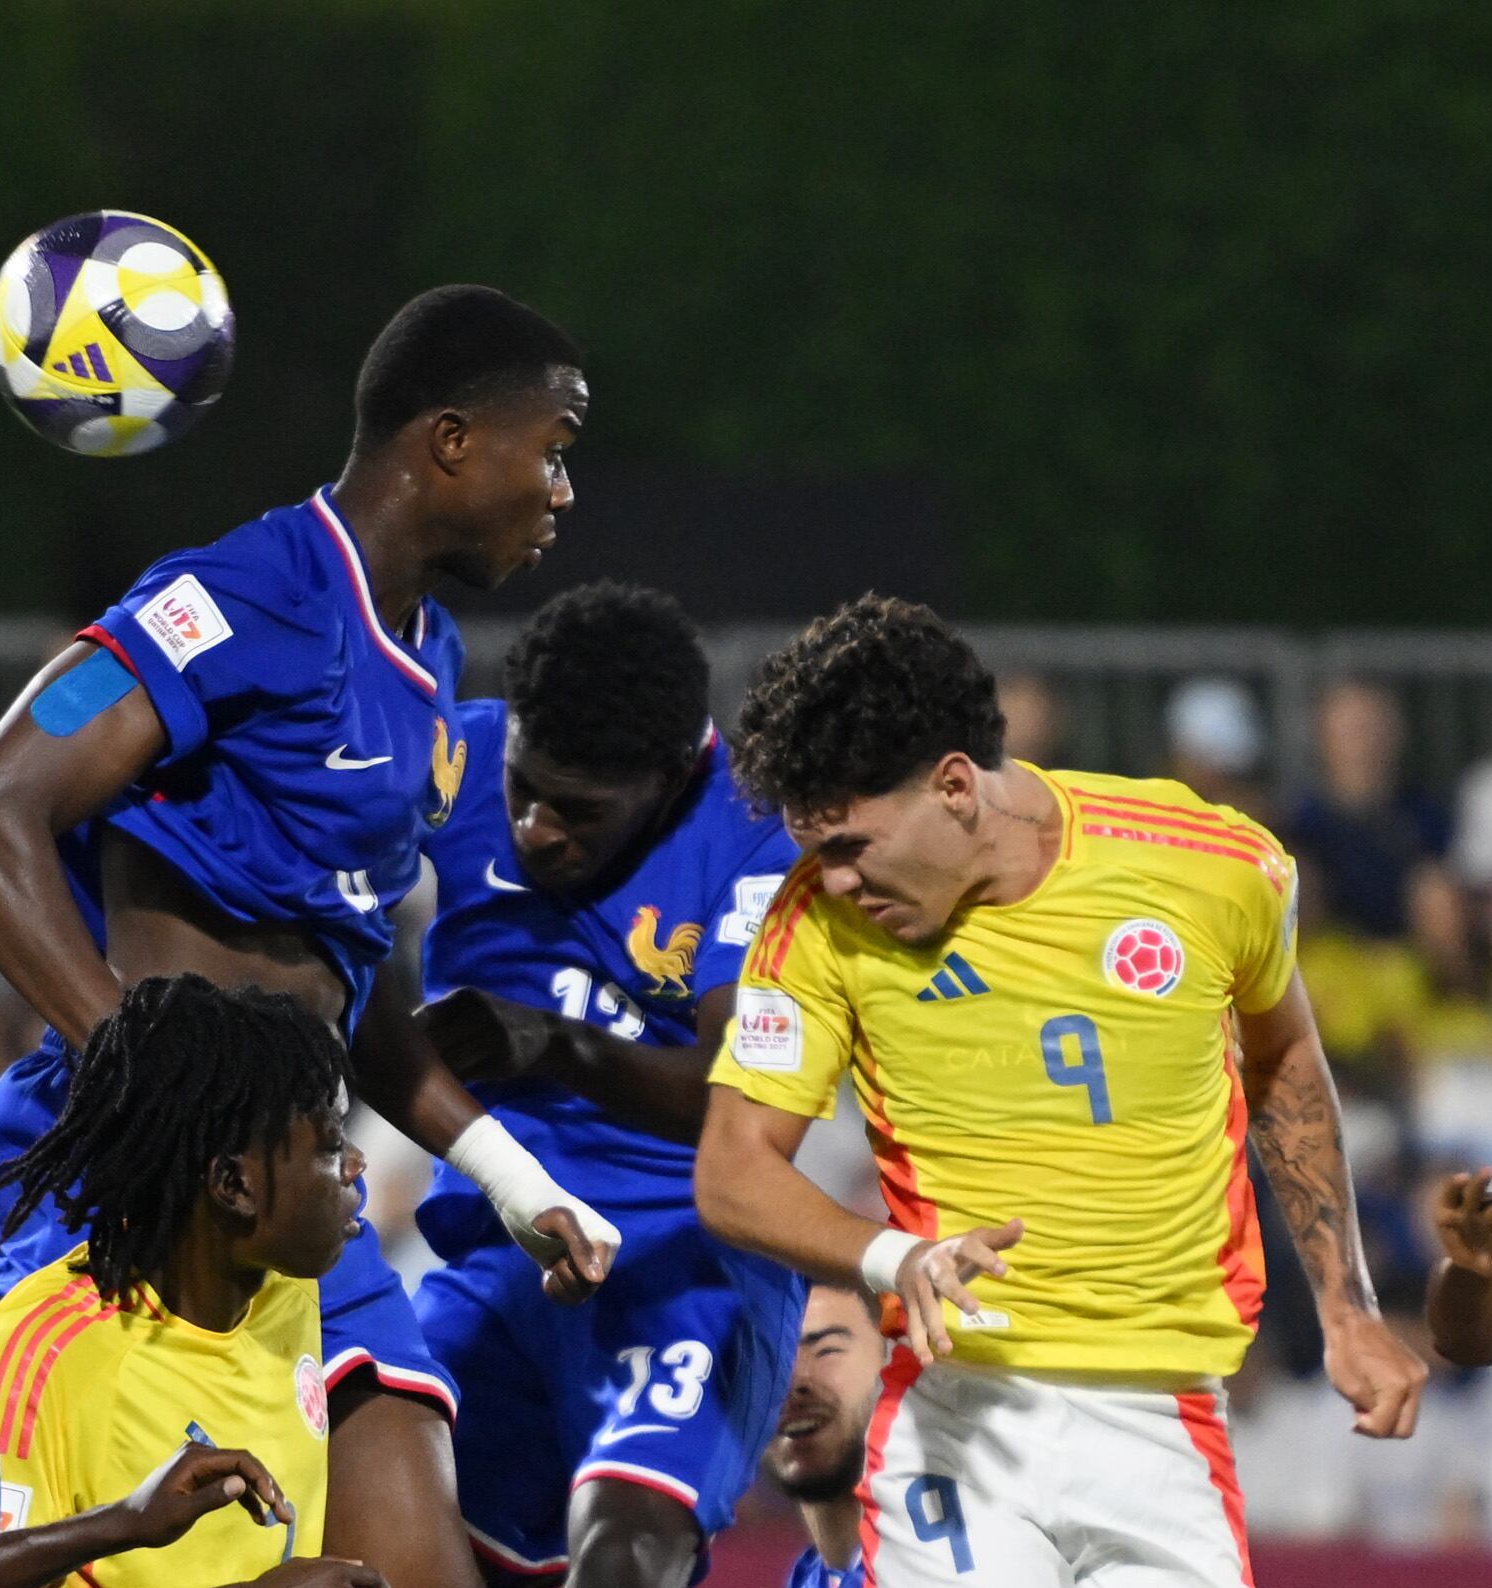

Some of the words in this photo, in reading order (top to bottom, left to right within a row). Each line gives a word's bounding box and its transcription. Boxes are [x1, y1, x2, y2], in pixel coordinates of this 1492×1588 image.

[1040, 1014, 1115, 1125] 9
[617, 1340, 713, 1419] 13
[905, 1474, 976, 1574] 9
